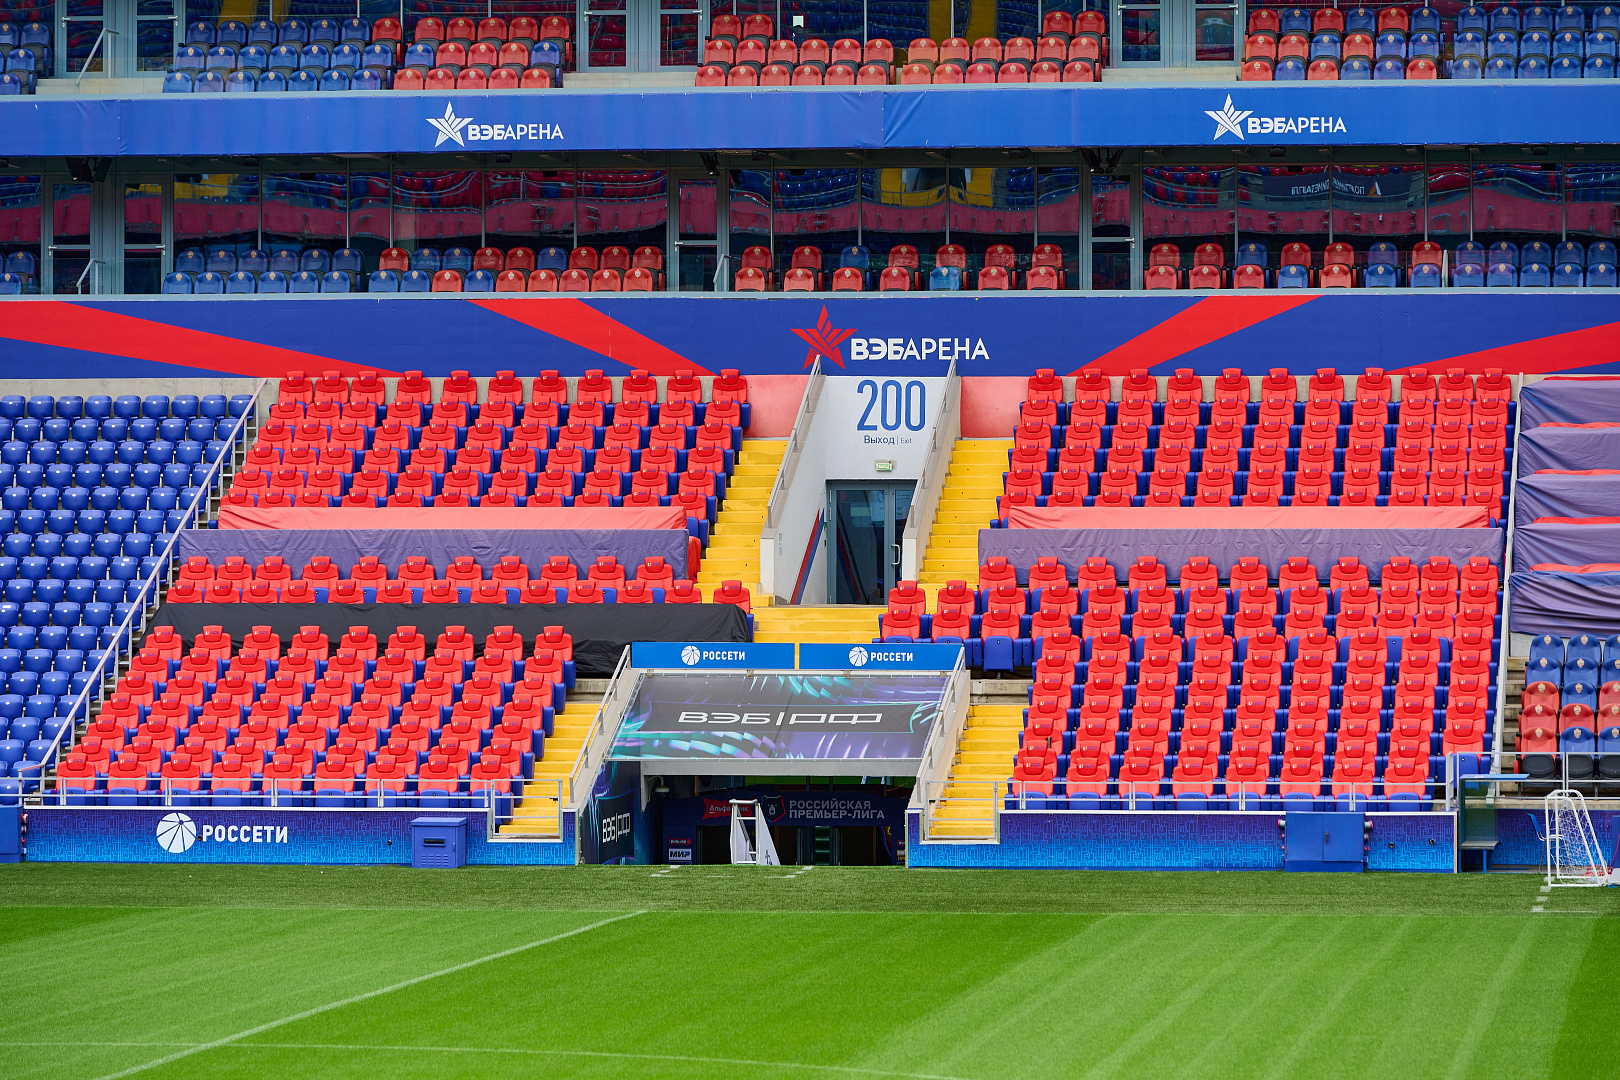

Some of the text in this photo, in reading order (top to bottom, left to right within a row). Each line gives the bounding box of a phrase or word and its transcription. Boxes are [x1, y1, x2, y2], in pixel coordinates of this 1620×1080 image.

[1247, 116, 1347, 134] ВЭБАРЕНА
[467, 124, 564, 141] ВЭБАРЕНА
[850, 337, 990, 360] ВЭБАРЕНА
[856, 379, 926, 432] 200
[864, 434, 895, 446] Выход
[702, 650, 746, 661] РОССЕТИ
[870, 651, 914, 662] РОССЕТИ
[789, 798, 872, 809] РОССИЙСКАЯ
[789, 809, 885, 819] ПРЕМЬЕР-ЛИГА
[201, 825, 288, 844] РОССЕТИ
[670, 850, 690, 858] МИР
